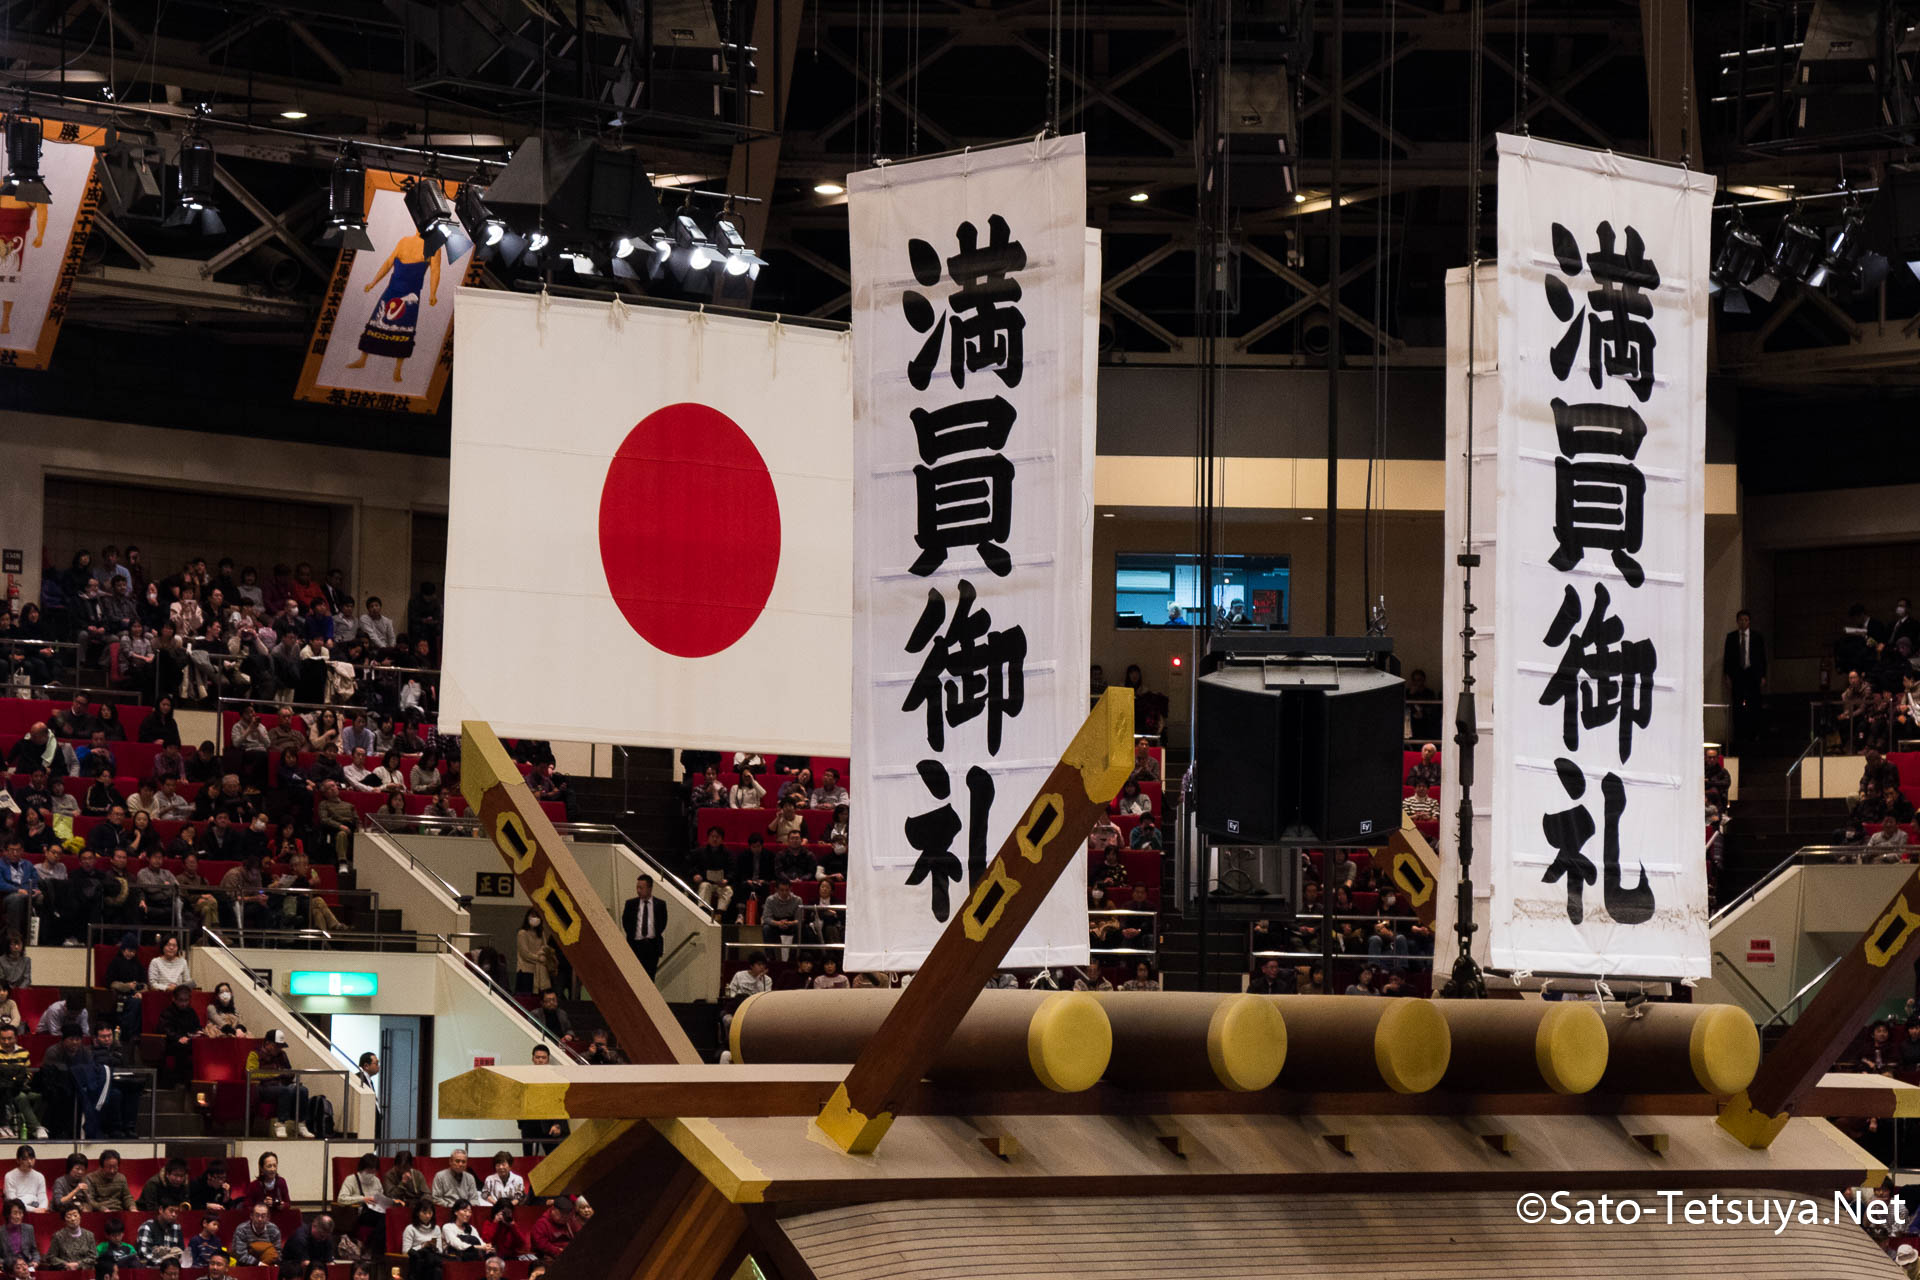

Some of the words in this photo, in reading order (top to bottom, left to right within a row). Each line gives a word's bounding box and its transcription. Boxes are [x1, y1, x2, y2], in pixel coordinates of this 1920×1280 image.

[902, 214, 1027, 922] 満員御礼
[1539, 220, 1661, 925] 満員御礼
